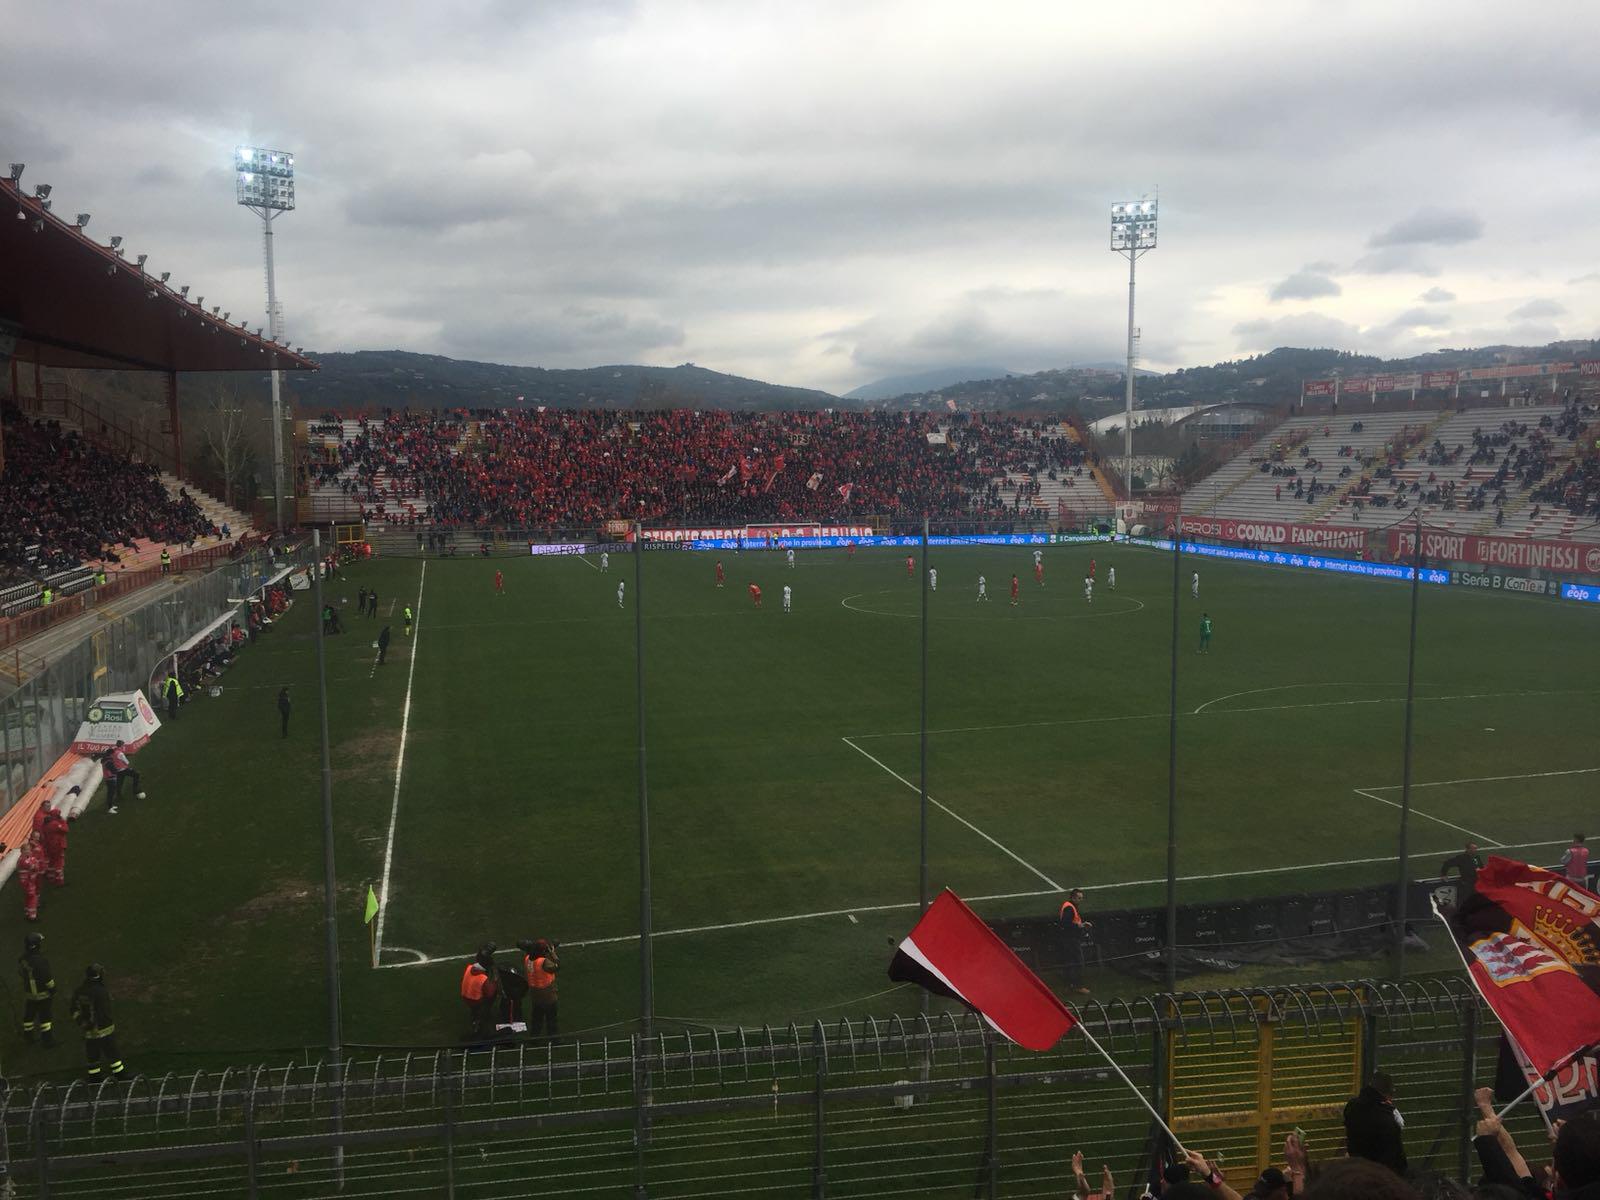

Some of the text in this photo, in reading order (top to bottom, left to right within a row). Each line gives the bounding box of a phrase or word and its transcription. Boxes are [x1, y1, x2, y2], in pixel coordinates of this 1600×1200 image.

[1236, 523, 1286, 543] CONAD
[1291, 524, 1365, 549] FARCHIONI
[644, 542, 681, 551] RISPETTO
[1427, 534, 1466, 560] SPORT
[1462, 572, 1490, 588] Serie
[1493, 575, 1501, 588] B
[104, 713, 122, 721] Rosi
